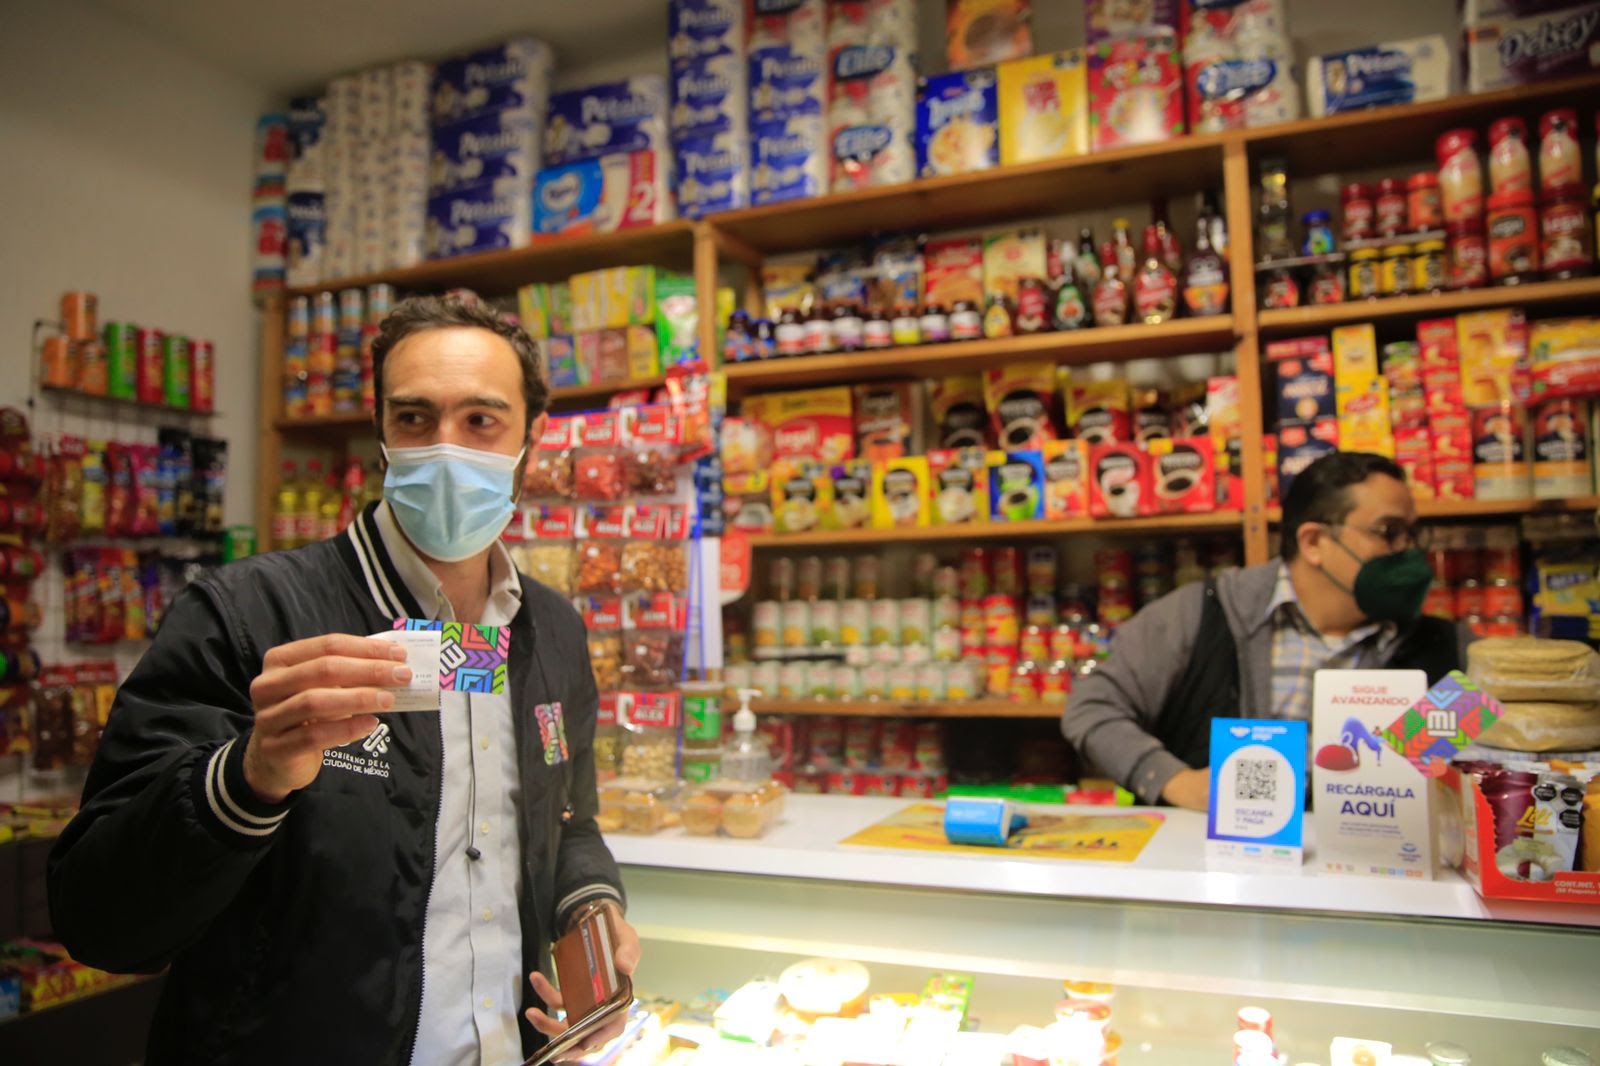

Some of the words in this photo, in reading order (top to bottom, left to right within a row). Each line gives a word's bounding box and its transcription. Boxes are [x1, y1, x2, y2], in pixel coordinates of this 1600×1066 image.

[1351, 685, 1389, 695] SIGUE
[1330, 695, 1410, 706] AVANZANDO
[322, 758, 352, 770] CIUDAD
[352, 764, 363, 774] DE
[363, 766, 389, 778] MÉXICO
[323, 749, 366, 765] GOBIERNO
[379, 761, 390, 769] LA
[1340, 799, 1396, 818] AQUÍ
